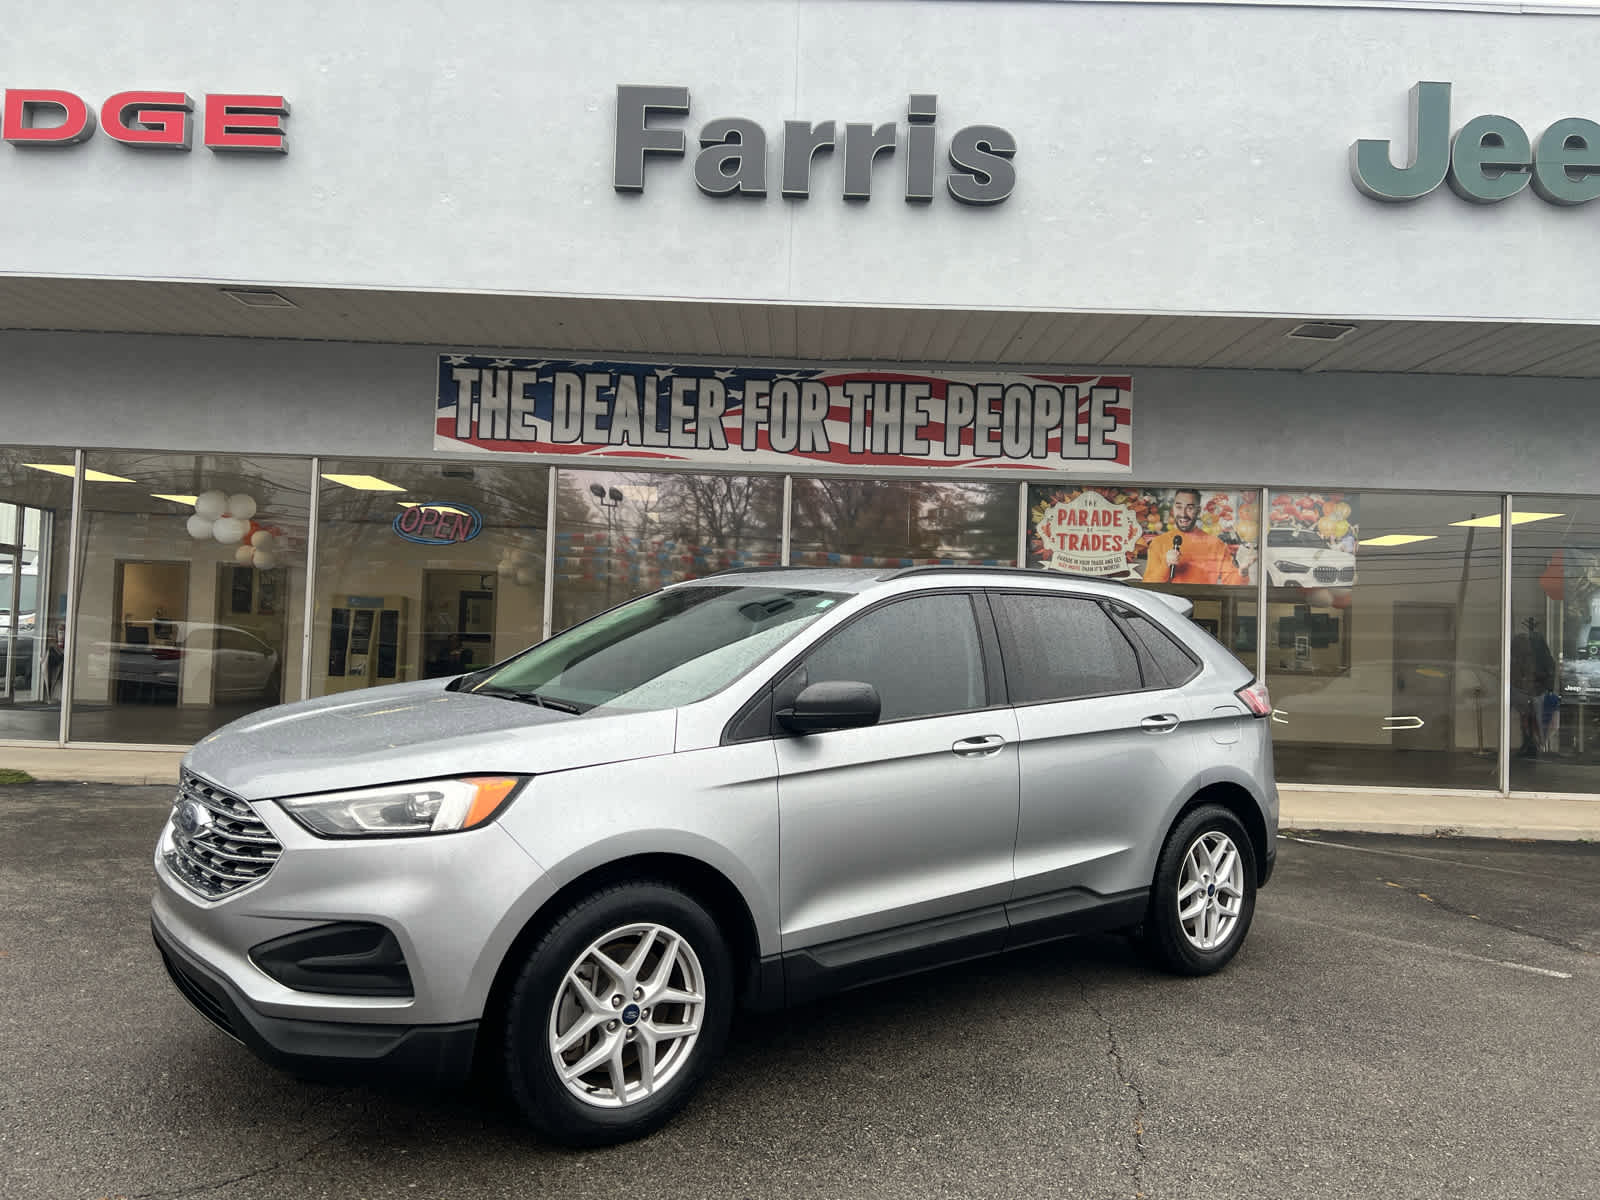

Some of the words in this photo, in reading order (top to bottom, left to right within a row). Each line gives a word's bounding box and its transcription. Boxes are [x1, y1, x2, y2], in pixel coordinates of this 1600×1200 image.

[2, 88, 290, 155] DGE
[613, 84, 1017, 206] Farris
[1349, 81, 1600, 207] Jee
[452, 367, 538, 442] THE
[550, 371, 729, 450] DEALER
[740, 377, 831, 453] FOR
[843, 380, 932, 456] THE
[944, 382, 1119, 460] PEOPLE
[400, 505, 472, 542] OPEN
[1056, 533, 1123, 552] TRADES
[1057, 508, 1123, 527] PARADE
